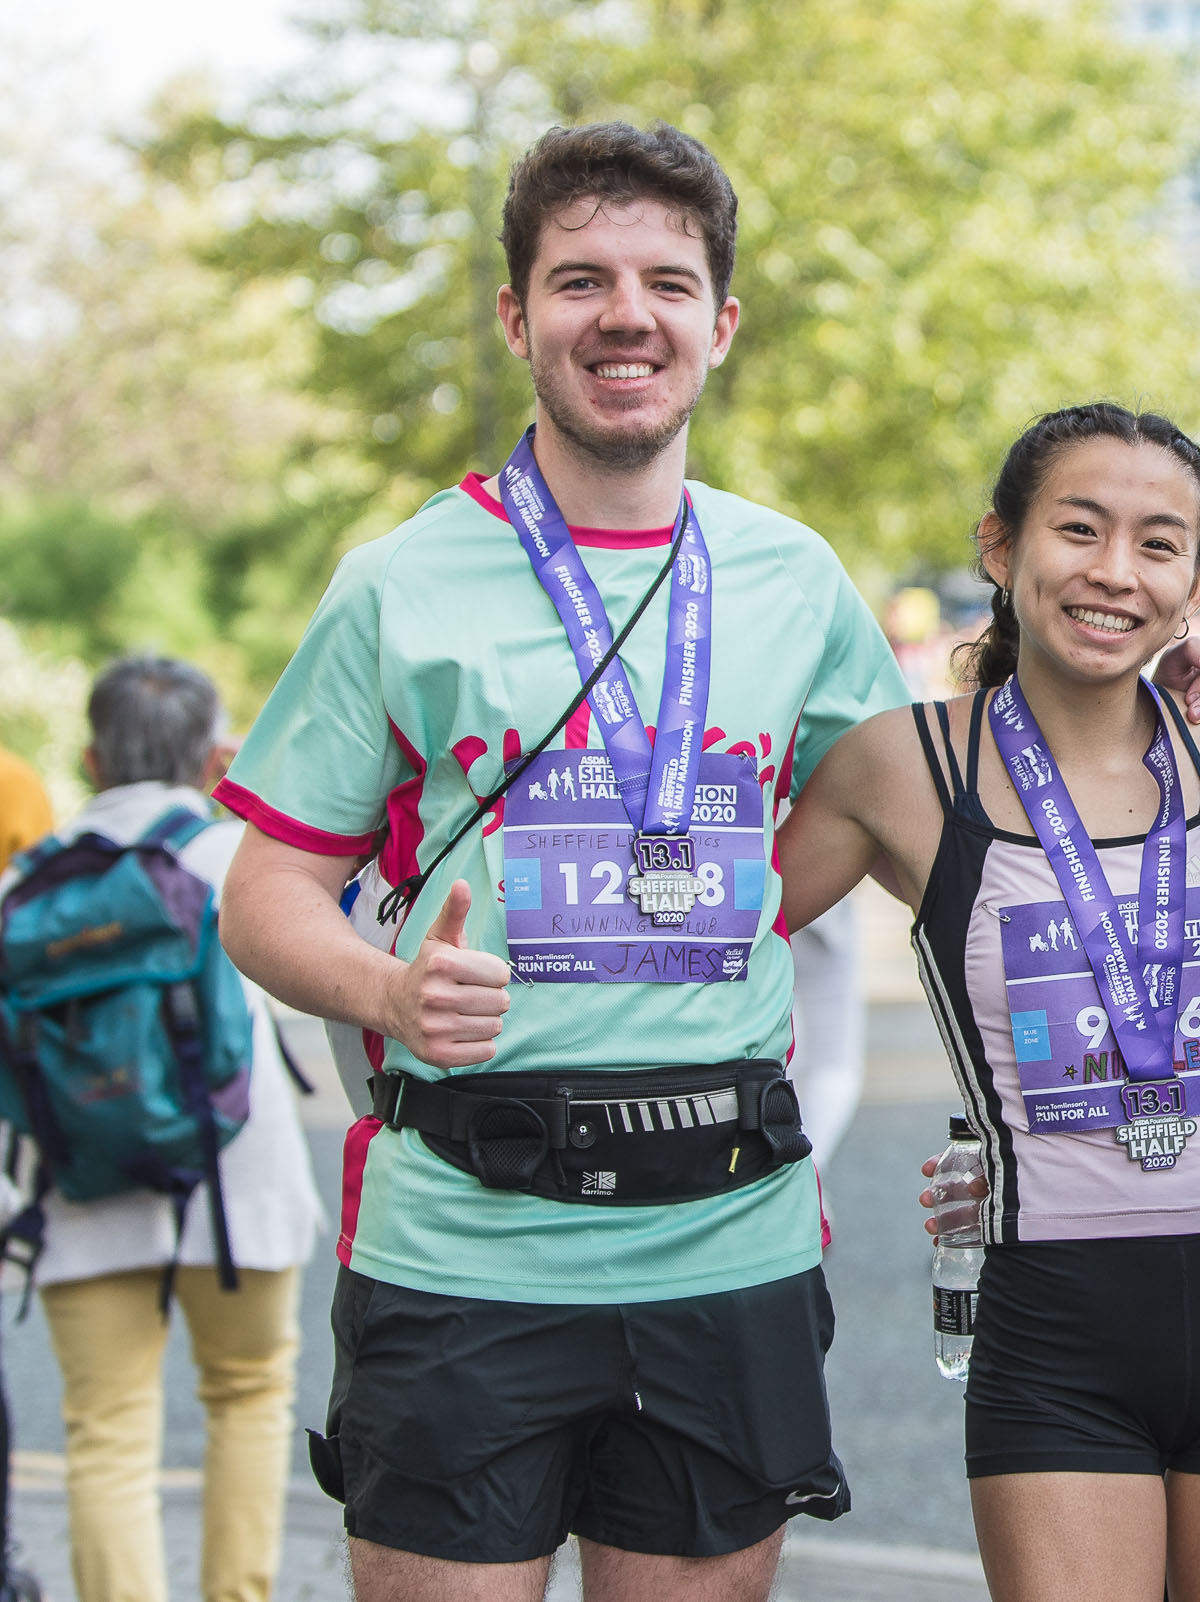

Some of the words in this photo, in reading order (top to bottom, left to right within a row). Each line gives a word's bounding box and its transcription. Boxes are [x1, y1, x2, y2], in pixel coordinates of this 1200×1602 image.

[516, 478, 544, 521] SHEFFIELD
[508, 484, 526, 507] HALF
[518, 506, 551, 558] MARATHON
[554, 565, 592, 628] FINISHER
[685, 602, 699, 639] 2020
[679, 641, 697, 706] FINISHER
[613, 680, 634, 718] Sheffield
[580, 756, 606, 765] ASDA
[678, 719, 695, 784] MARATHON
[1154, 745, 1174, 787] HEFFIELD
[581, 783, 622, 800] HAL
[663, 758, 679, 808] SHEFFIELD
[673, 785, 686, 810] HALF
[1149, 753, 1164, 769] ALF
[1159, 770, 1171, 828] MARATHON
[691, 805, 736, 823] 2020
[1041, 798, 1067, 836] 2020
[524, 833, 635, 850] SHEFFIELD
[639, 842, 692, 869] 13.1
[558, 861, 726, 907] 128
[1059, 835, 1096, 902] FINISHER
[1156, 836, 1171, 907] FINISHER
[631, 880, 704, 893] SHEFFIELD
[643, 893, 694, 912] HALF
[552, 913, 649, 935] RUNNING
[656, 912, 684, 923] 2020
[1154, 909, 1169, 950] 2020
[1099, 910, 1129, 973] MARATHON
[518, 961, 546, 972] RUN
[546, 961, 571, 972] FOR
[573, 960, 596, 971] ALL
[602, 944, 722, 979] JAMES
[1105, 953, 1129, 1005] SHEFFIELD
[1121, 975, 1138, 1001] HALF
[1163, 966, 1176, 1006] Sheffield
[1036, 1111, 1062, 1122] RUN
[1062, 1109, 1085, 1120] FOR
[1088, 1106, 1110, 1118] ALL
[1050, 1100, 1088, 1110] Tomlinson's
[1127, 1084, 1182, 1116] 13.1
[1118, 1121, 1196, 1141] SHEFFIELD
[1149, 1116, 1179, 1124] Foundation
[1130, 1136, 1184, 1158] HALF
[1145, 1156, 1174, 1168] 2020
